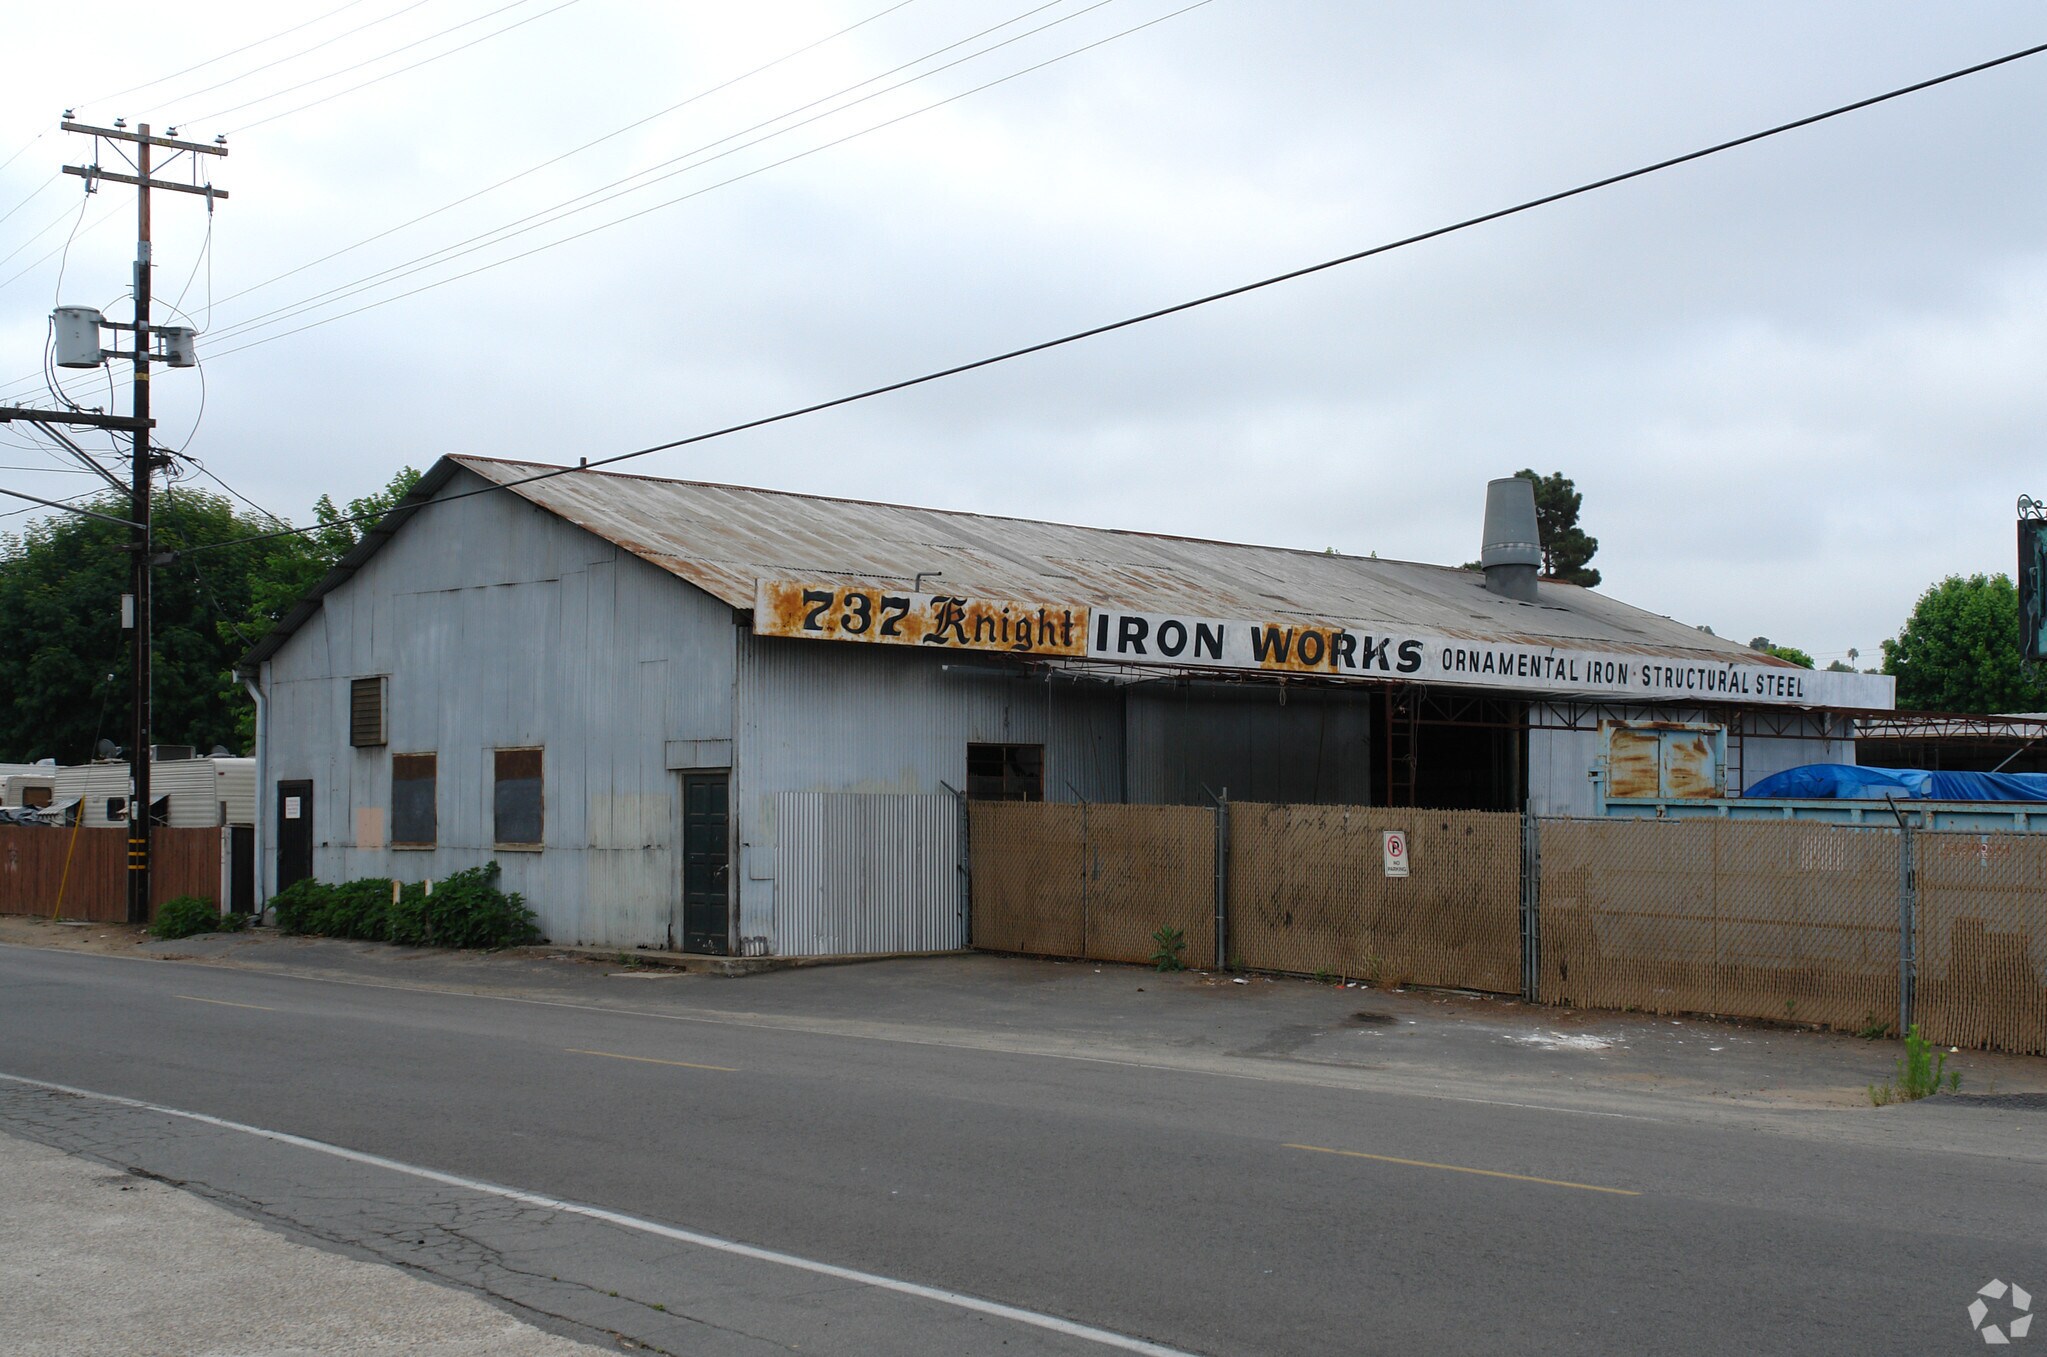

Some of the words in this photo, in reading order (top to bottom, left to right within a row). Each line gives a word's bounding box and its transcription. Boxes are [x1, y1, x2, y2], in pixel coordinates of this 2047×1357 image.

[803, 588, 910, 637] 737
[922, 595, 1075, 652] Knight
[1096, 613, 1225, 660] IRON
[1250, 626, 1424, 673] WORKS
[1442, 647, 1579, 681] ORNAMENTAL
[1586, 660, 1628, 685] IRON
[1642, 665, 1749, 694] STRUCTURAL
[1756, 674, 1804, 698] STEEL
